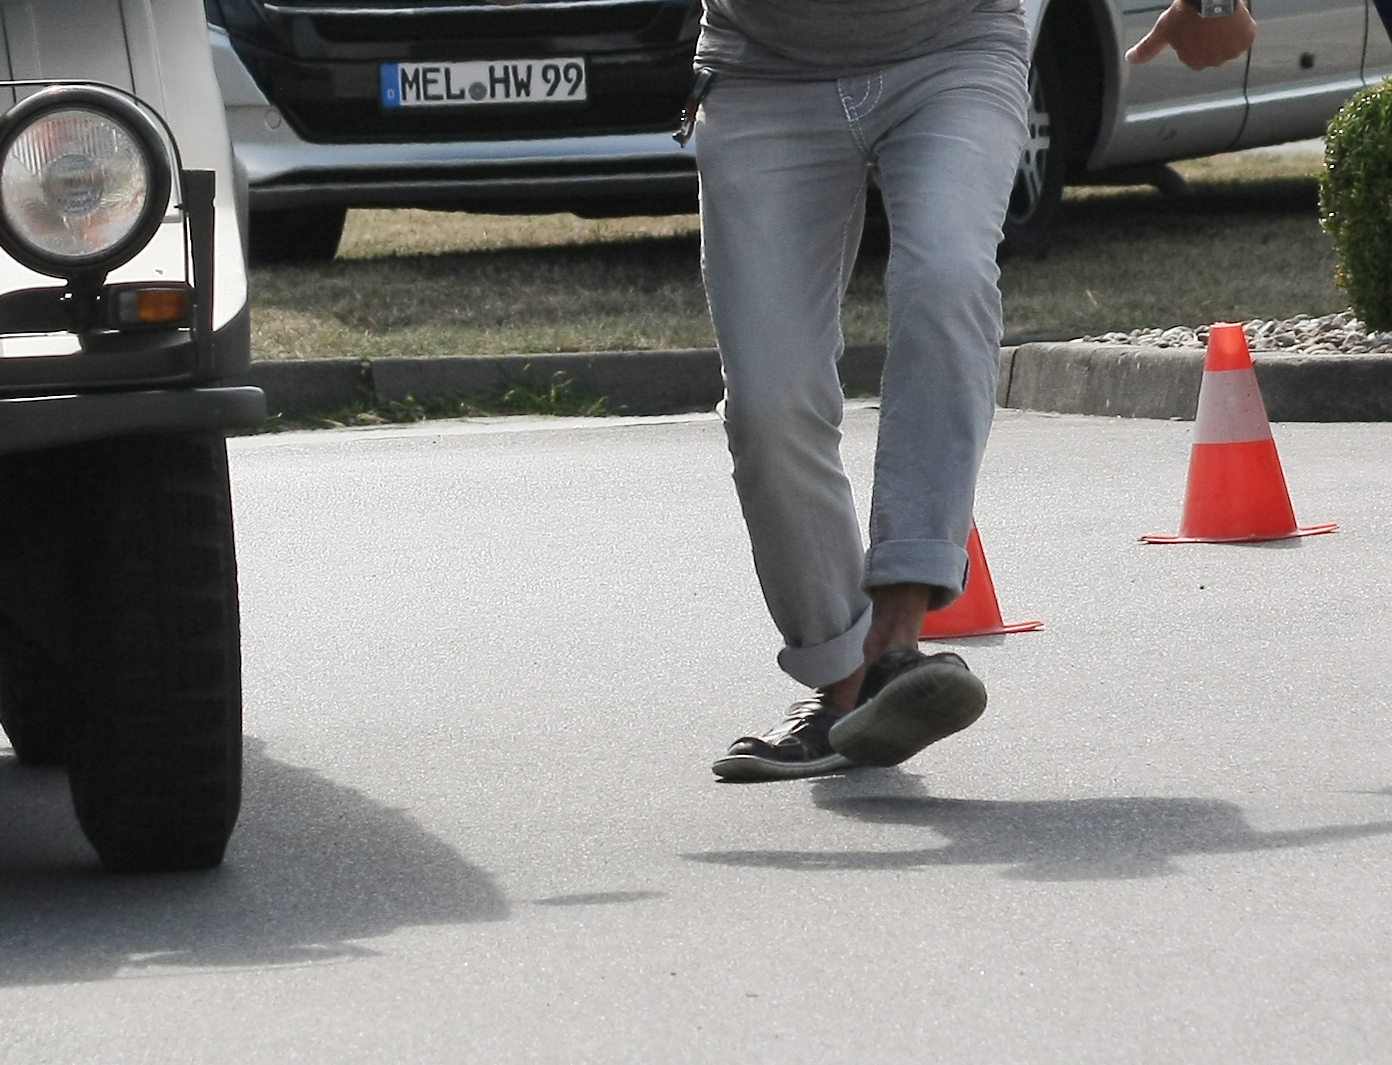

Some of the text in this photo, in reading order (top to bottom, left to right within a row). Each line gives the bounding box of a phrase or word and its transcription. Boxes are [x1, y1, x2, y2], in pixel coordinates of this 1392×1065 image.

[400, 66, 466, 101] MEL
[488, 63, 533, 98] HW
[541, 61, 583, 97] 99
